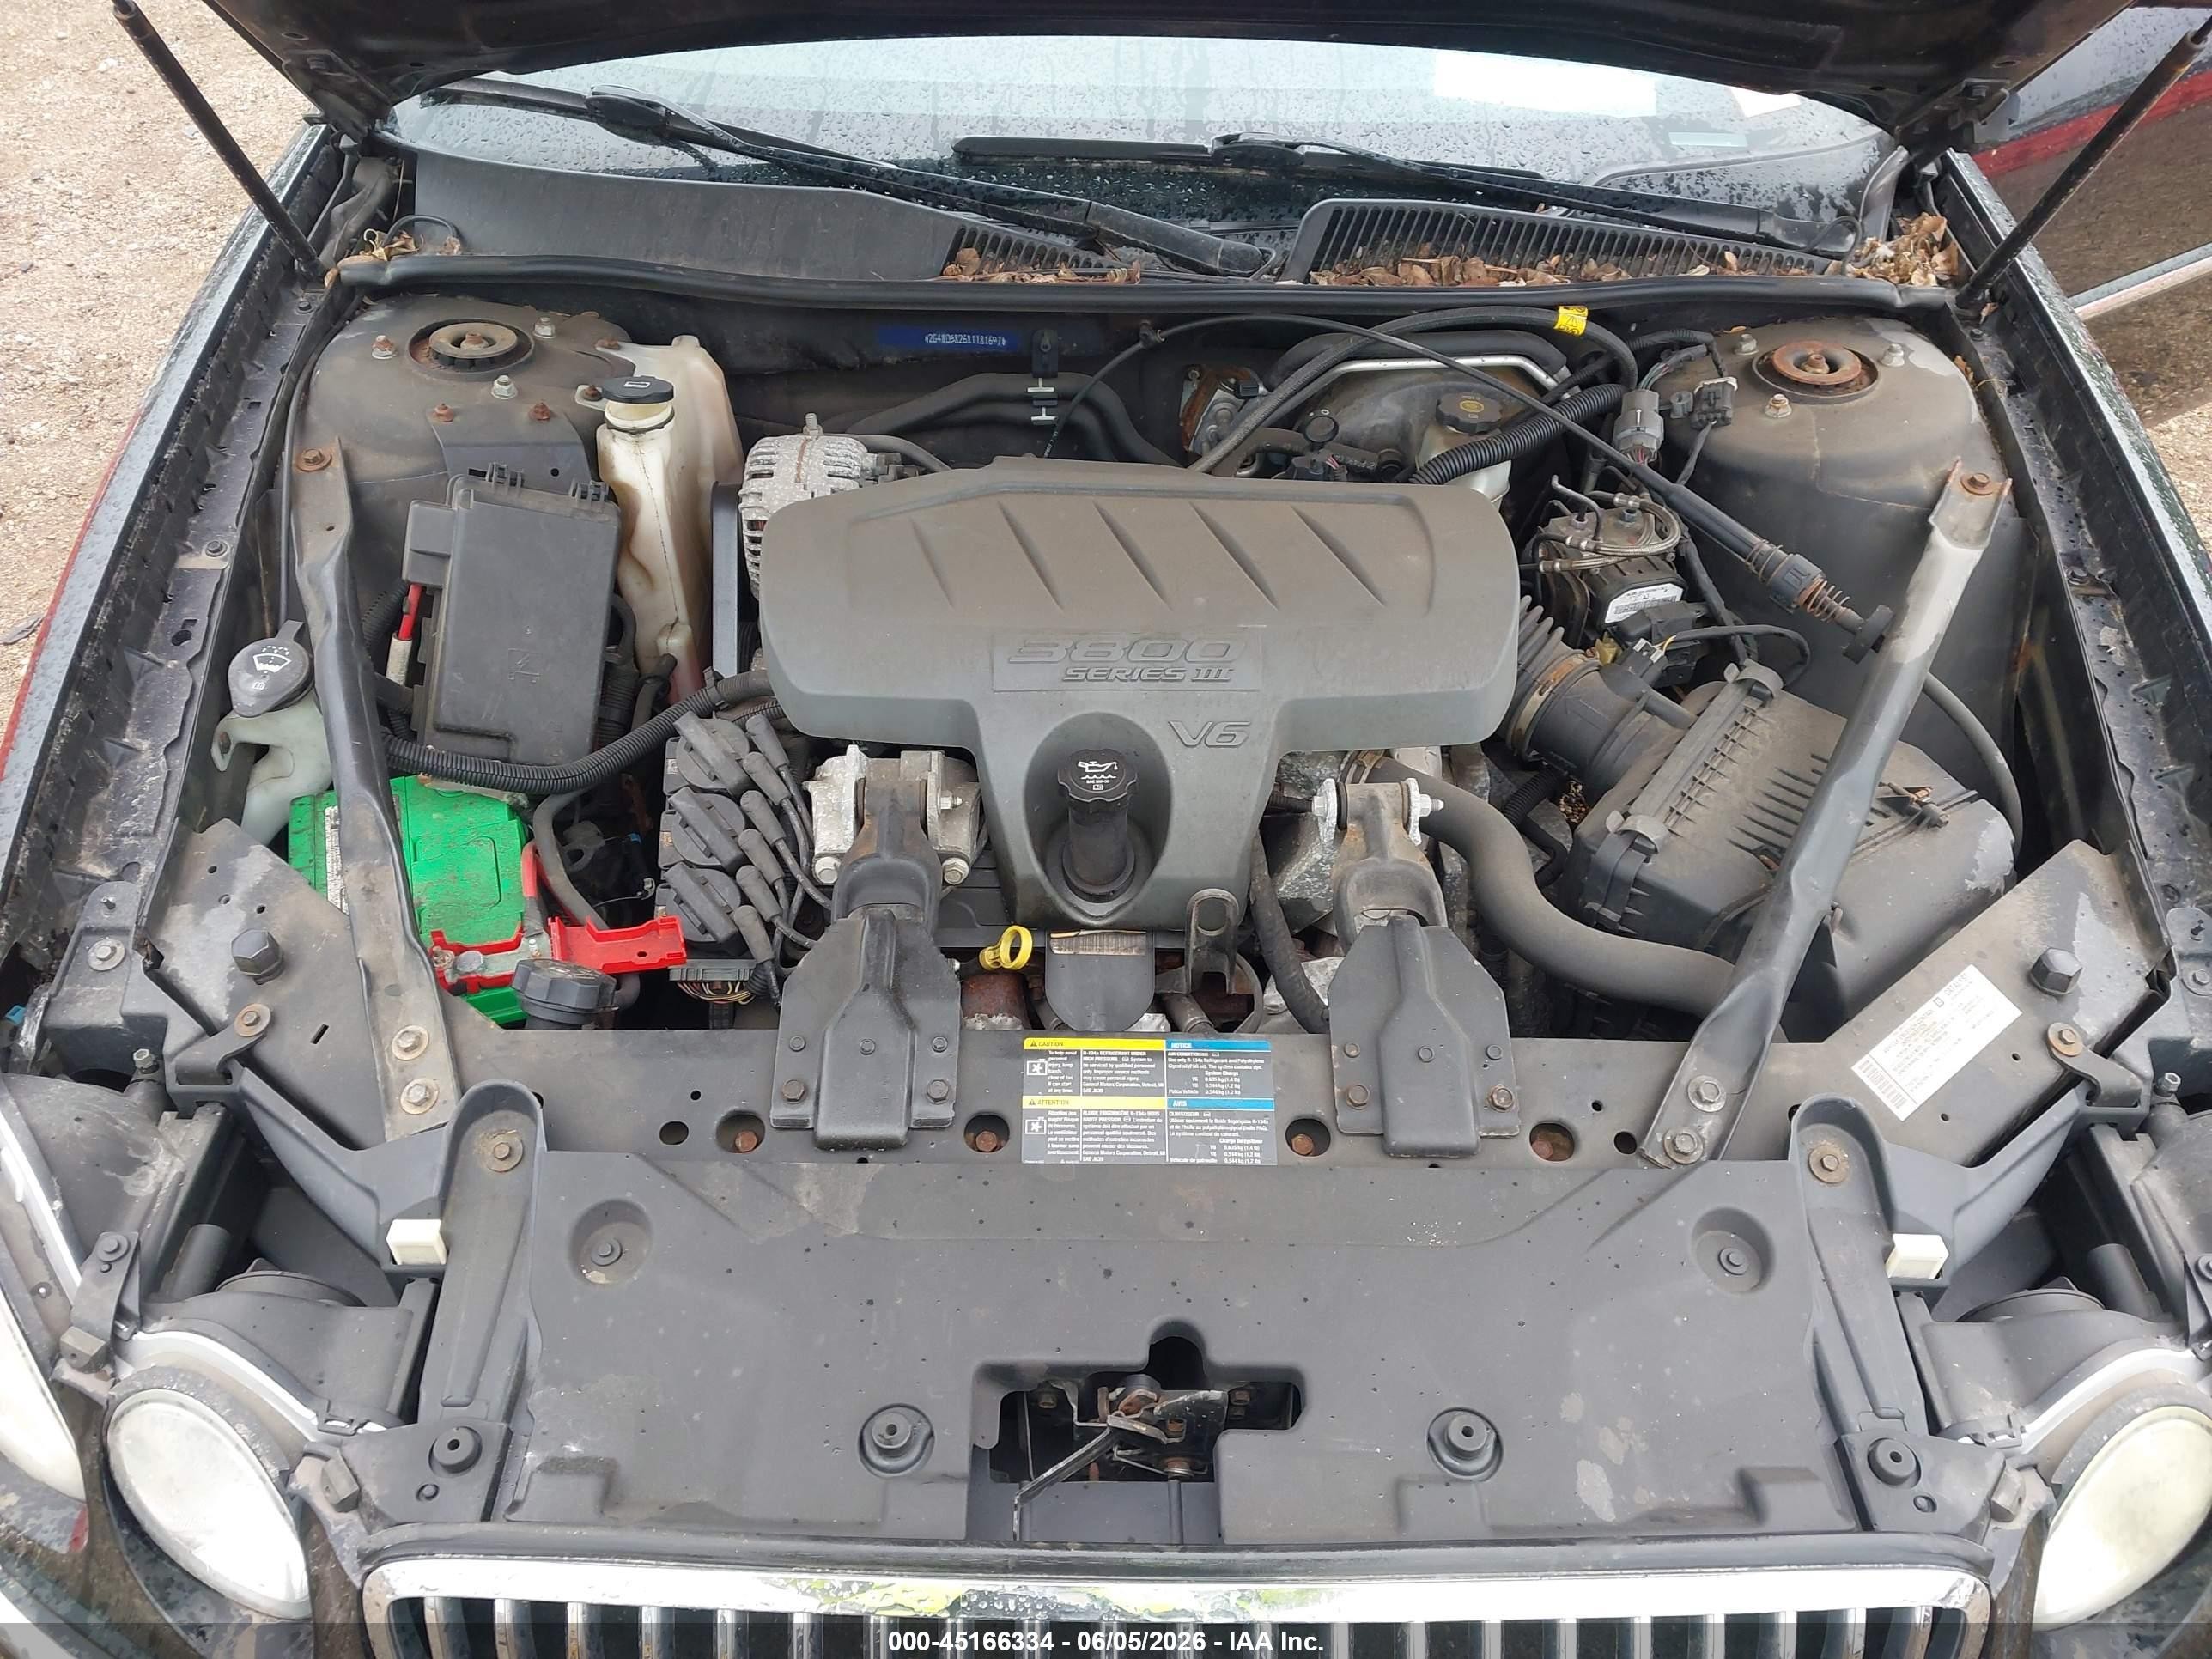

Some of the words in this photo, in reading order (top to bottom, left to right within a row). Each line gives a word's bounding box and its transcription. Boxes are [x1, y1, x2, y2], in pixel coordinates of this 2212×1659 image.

[1007, 636, 1247, 665] 3800
[1061, 666, 1187, 683] SERIES
[1190, 666, 1235, 683] III
[1167, 720, 1251, 748] V6
